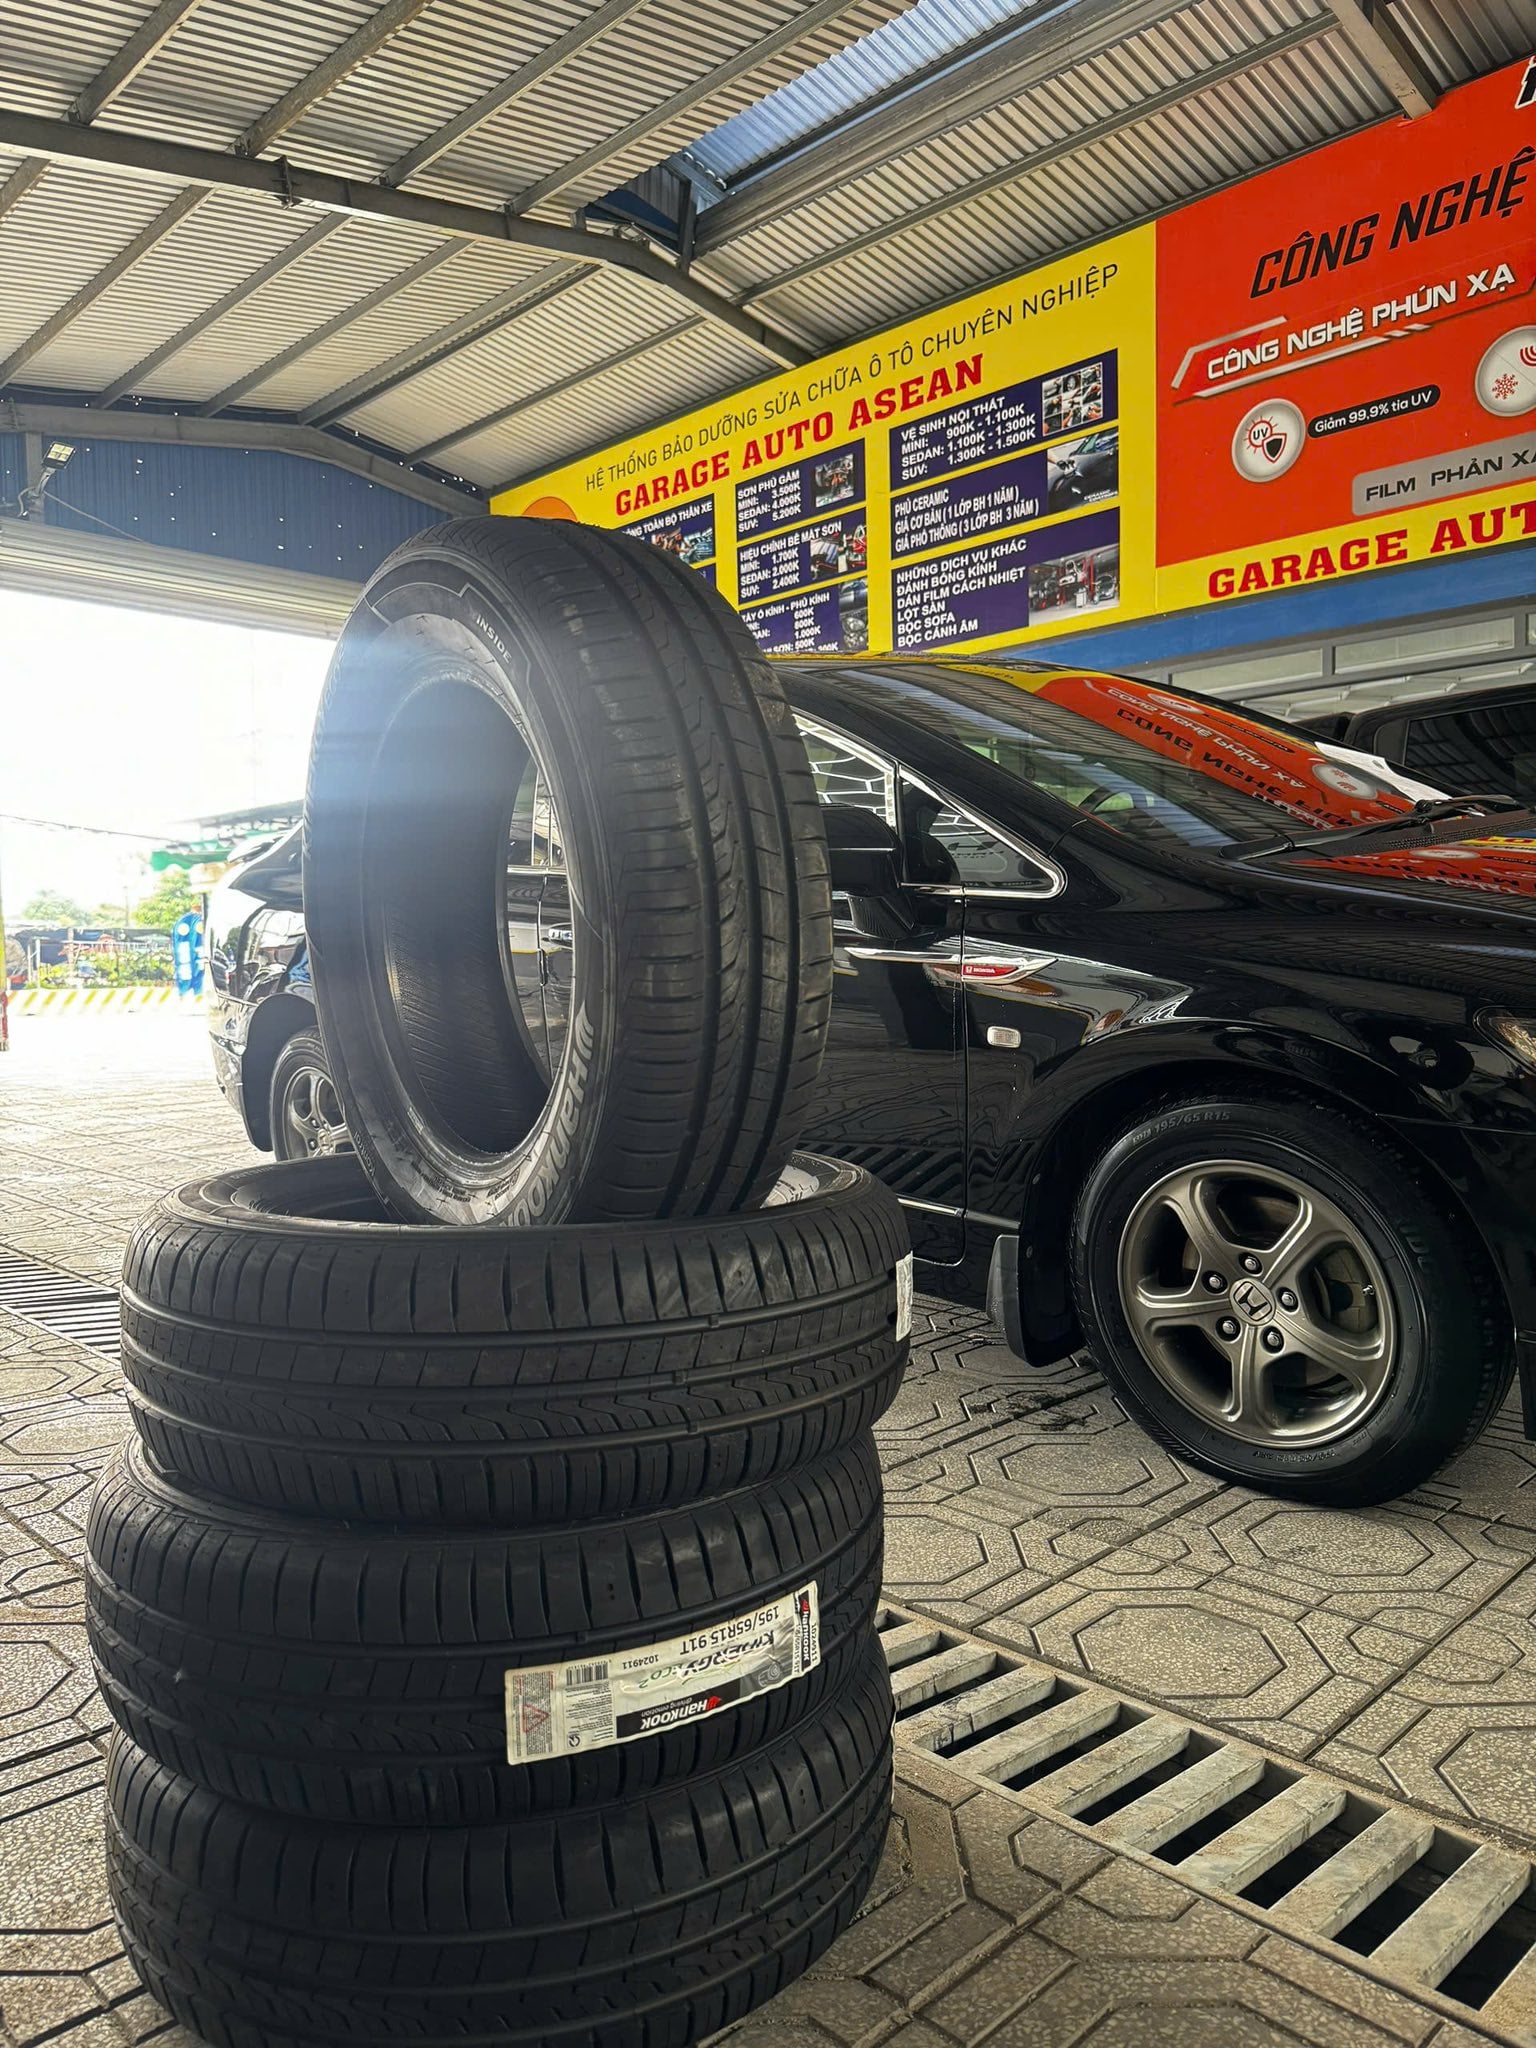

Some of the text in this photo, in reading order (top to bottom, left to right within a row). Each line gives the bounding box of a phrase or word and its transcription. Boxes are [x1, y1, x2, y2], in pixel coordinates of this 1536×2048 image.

[1250, 146, 1536, 299] CÔNG NGHỆ
[1207, 264, 1515, 380] CÔNG NGHỆ PHÚN XẠ
[586, 263, 1118, 492] HỆ THỐNG BẢO DƯỠNG SỬA CHỮA Ô TÔ CHUYÊN NGHIỆP
[901, 427, 916, 441] VỆ
[919, 416, 946, 436] SINH
[949, 408, 970, 425] NỘI
[1315, 416, 1347, 433] Giảm
[1391, 400, 1409, 412] tia
[1410, 390, 1432, 407] UV
[616, 353, 984, 516] GARAGE AUTO ASEAN
[902, 438, 928, 455] MINI:
[946, 420, 975, 439] 900K
[985, 403, 1025, 427] 1.100K
[902, 445, 944, 467] SEDAN:
[947, 431, 986, 452] 1.100K
[996, 413, 1036, 436] 1.300K
[1253, 427, 1269, 440] UV
[902, 464, 928, 480] SUV:
[947, 444, 986, 465] 1.300K
[996, 427, 1036, 450] 1.500K
[1366, 449, 1536, 502] FILM PHẢN X
[701, 501, 712, 513] XE
[737, 485, 757, 499] SƠN
[737, 481, 800, 510] MINI: 3.500K
[738, 493, 801, 521] SEDAN: 4.000K
[913, 488, 949, 510] CERAMIC
[738, 504, 801, 532] SUV: 5.200K
[895, 517, 909, 535] GIÁ
[910, 513, 923, 530] CƠ
[954, 498, 971, 517] LỚP
[973, 493, 985, 511] BH
[994, 486, 1014, 504] NĂM
[895, 534, 909, 552] GIÁ
[929, 520, 957, 545] THÔNG
[970, 510, 987, 530] LỚP
[990, 508, 1002, 526] BH
[1013, 498, 1034, 519] NĂM
[822, 521, 842, 536] SƠN
[740, 548, 799, 573] MINI: 1.700K
[741, 560, 799, 586] SEDAN: 2.000K
[896, 538, 1027, 583] NHỮNG DỊCH VỤ KHÁC
[1208, 529, 1408, 598] GARAGE
[741, 573, 799, 598] SUV: 2.400K
[896, 560, 997, 596] ĐÁNH BÓNG KÍNH
[897, 566, 1026, 609] DÁN FILM CÁCH NHIỆT
[476, 614, 512, 664] INSIDE
[752, 629, 770, 639] DAN:
[794, 626, 821, 639] 1.000K
[897, 612, 955, 636] BỌC SOFA
[897, 633, 922, 648] BỌC
[1204, 1111, 1231, 1121] R15
[500, 1049, 589, 1226] Hankoo
[711, 1605, 779, 1645] 195/65R15
[622, 1654, 659, 1670] 1024911
[680, 1639, 707, 1655] 91T
[641, 1704, 669, 1717] emotion
